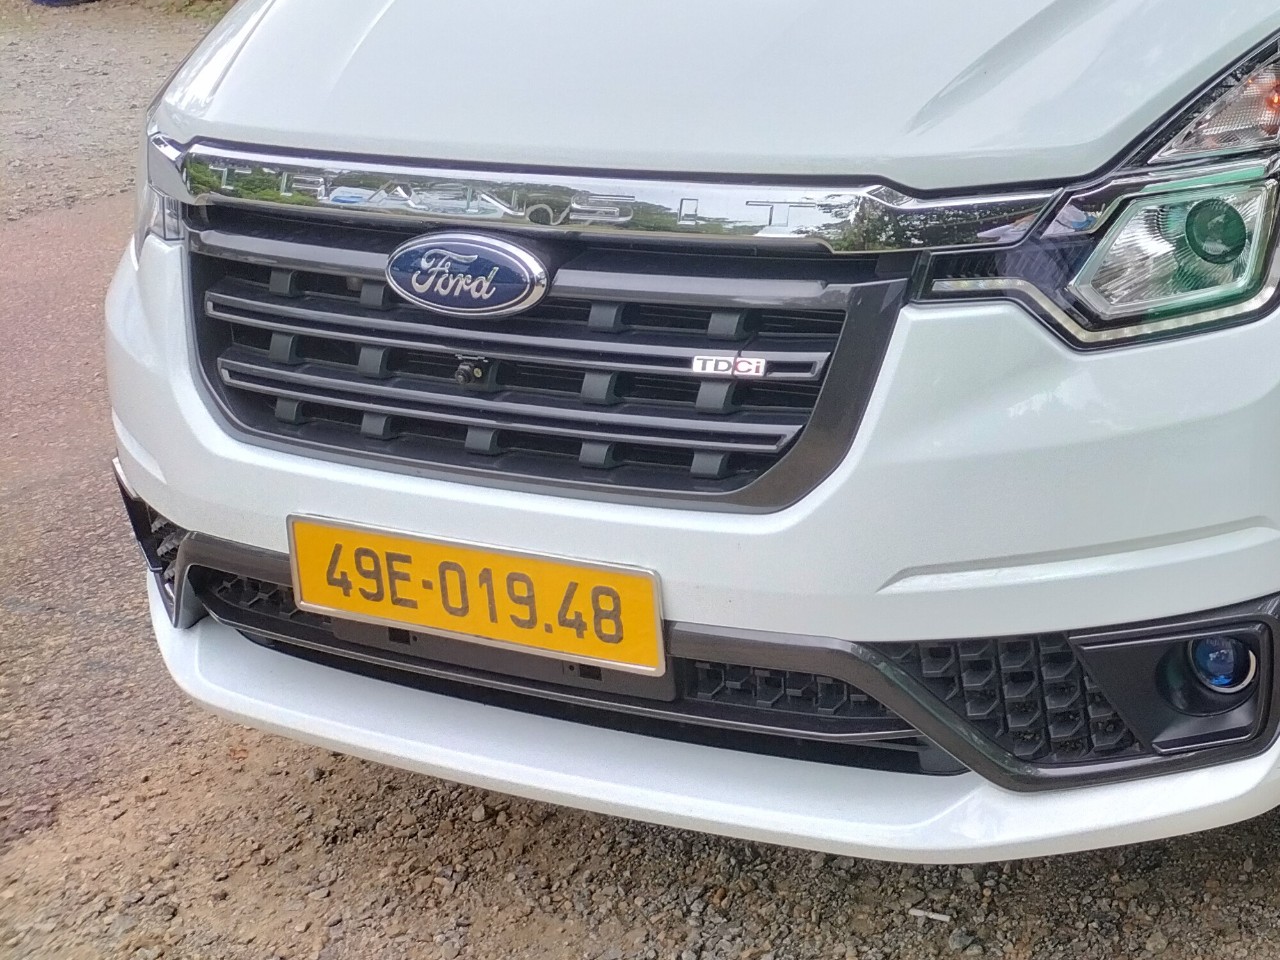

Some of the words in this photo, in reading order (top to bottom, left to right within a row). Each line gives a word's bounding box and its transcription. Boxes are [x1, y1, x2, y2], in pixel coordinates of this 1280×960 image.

[411, 248, 500, 300] Ford
[696, 357, 761, 374] TDCi
[326, 543, 624, 644] 49E-019.48
